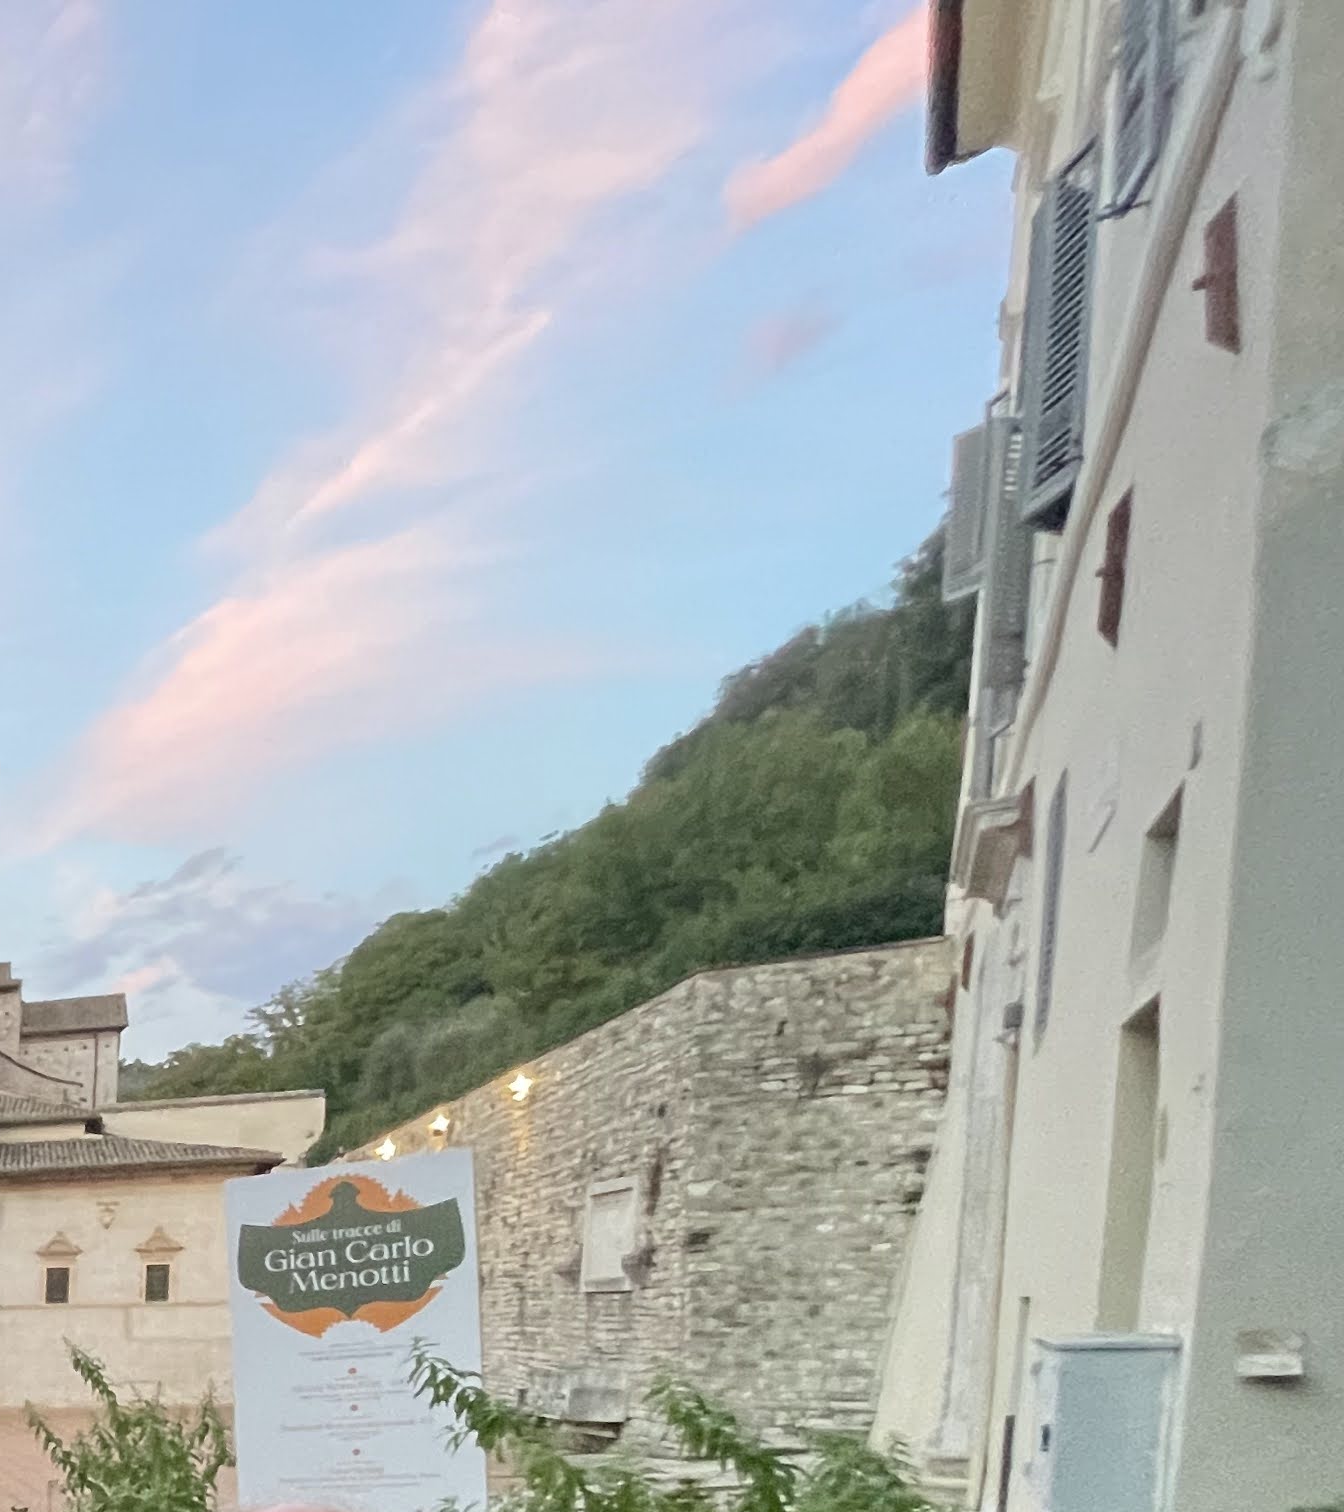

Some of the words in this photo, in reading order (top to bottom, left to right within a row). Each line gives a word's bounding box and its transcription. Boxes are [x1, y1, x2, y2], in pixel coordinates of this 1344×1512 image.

[291, 1228, 329, 1244] Sulle
[332, 1223, 383, 1241] tracce
[386, 1218, 402, 1234] di
[264, 1248, 337, 1273] Gian
[345, 1235, 435, 1264] Carlo
[288, 1259, 411, 1295] Menotti
